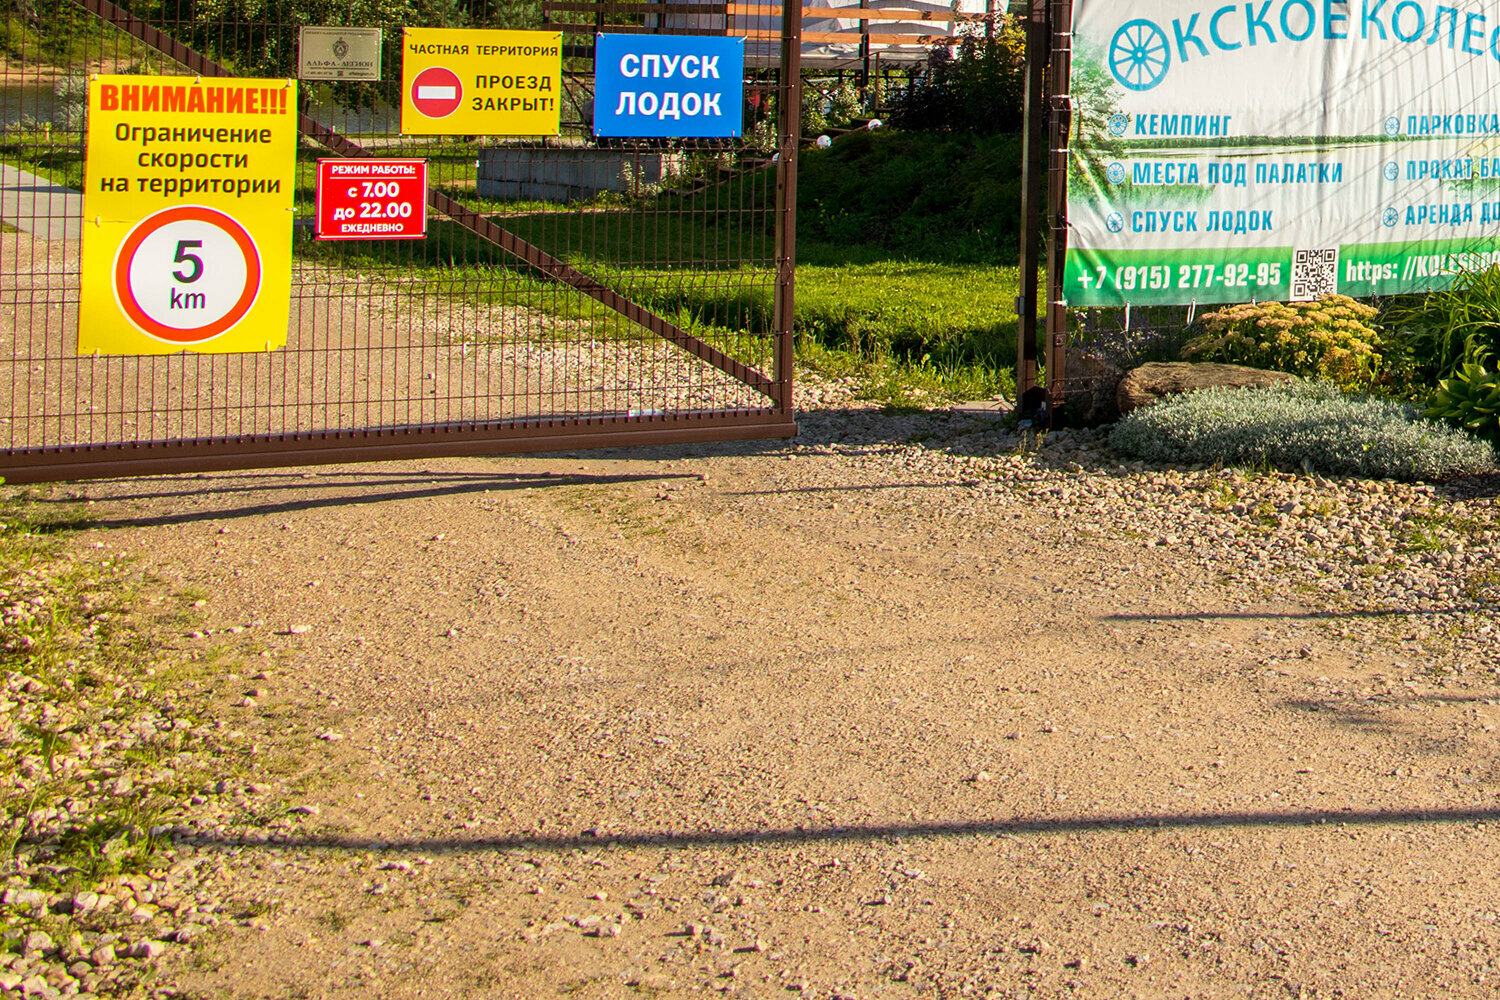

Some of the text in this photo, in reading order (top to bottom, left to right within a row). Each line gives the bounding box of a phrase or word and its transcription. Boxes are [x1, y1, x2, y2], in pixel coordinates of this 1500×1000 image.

[410, 44, 558, 56] ЧАСТНАЯ ТЕРРИТОРИЯ
[619, 53, 720, 80] СПУСК
[475, 75, 551, 92] ПРОЕЗД
[100, 84, 287, 115] ВНИМАНИЕ!!!
[472, 97, 554, 111] ЗАКРЫТ!
[615, 91, 722, 120] ЛОДОК
[115, 123, 272, 147] Ограничение
[1135, 114, 1231, 136] КЕМПИНГ
[1407, 114, 1500, 135] ПАРКОВКА
[138, 151, 249, 172] скорости
[331, 165, 416, 174] РЕЖИМ РАБОТЫ:
[1406, 158, 1473, 180] ПРОКАТ
[1133, 163, 1343, 187] МЕСТА ПОД ПАЛАТКИ
[100, 177, 281, 198] на территории
[347, 181, 400, 198] с 7.00
[333, 202, 412, 220] до 22.00
[1405, 203, 1472, 226] АРЕНДА
[341, 223, 404, 234] ЕЖЕДНЕВНО
[1133, 211, 1273, 234] СПУСК ЛОДОК
[171, 240, 204, 283] 5
[1346, 259, 1398, 285] https:
[1077, 263, 1281, 290] +7 (915) 277-92-95
[170, 288, 206, 310] km
